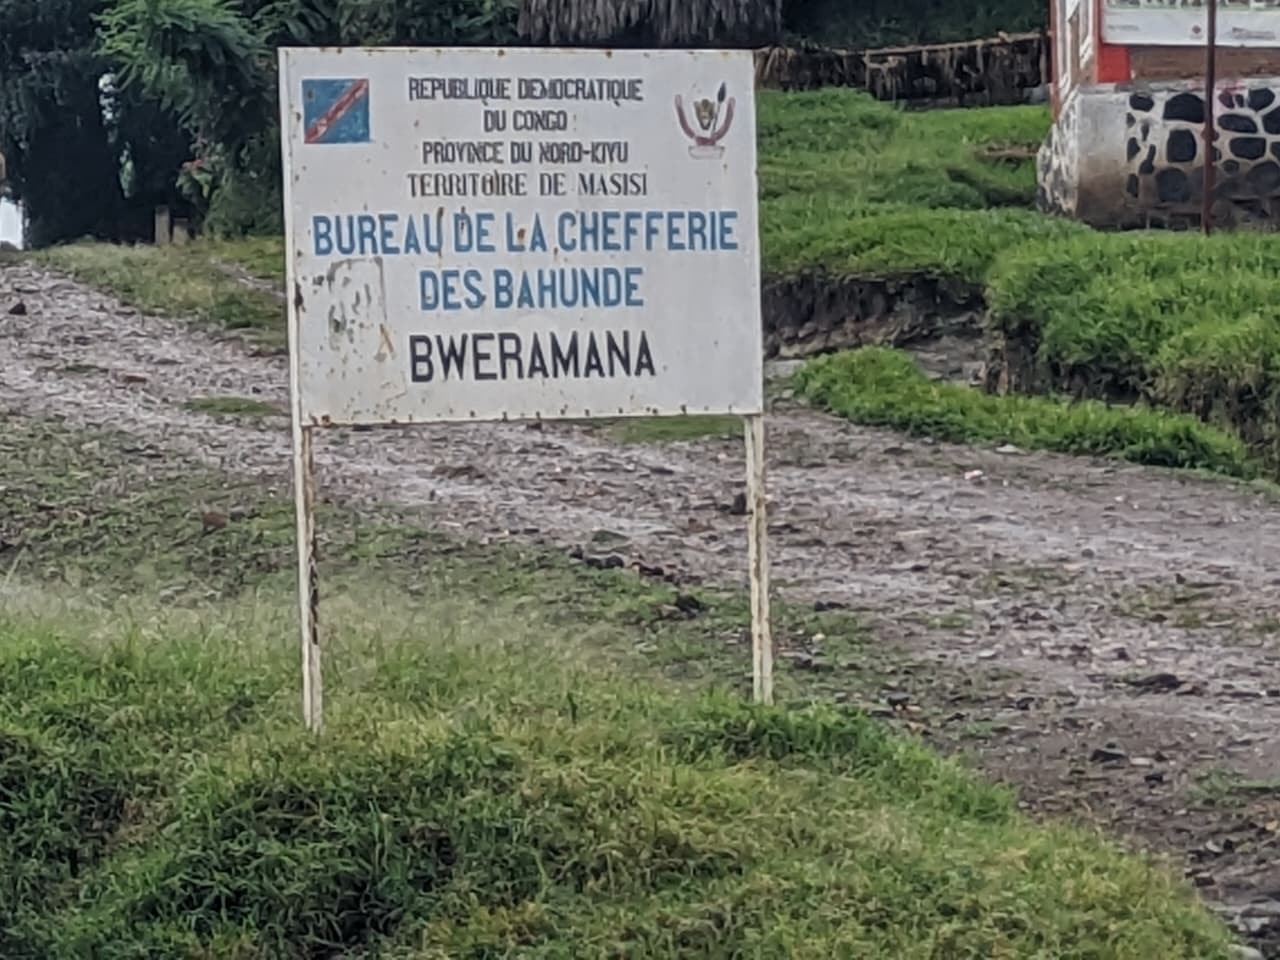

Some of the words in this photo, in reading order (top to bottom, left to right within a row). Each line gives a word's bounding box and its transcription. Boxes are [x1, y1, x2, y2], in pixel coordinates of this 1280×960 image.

[408, 77, 511, 106] REPUBLIQUE
[483, 110, 507, 132] DU
[513, 110, 568, 131] CONGO
[423, 141, 504, 164] PROVINCE
[510, 141, 532, 164] DU
[539, 141, 627, 163] NORD-KIVU
[407, 172, 528, 197] TERRITOIRE
[539, 173, 566, 196] DE
[578, 173, 648, 196] MASISI
[313, 213, 443, 256] BUREAU
[454, 213, 496, 254] DE
[507, 213, 554, 253] LA
[558, 211, 738, 252] CHEFFERIE
[420, 269, 486, 311] DES
[494, 268, 644, 309] BAHUNDE
[410, 331, 656, 382] BWERAMANA
